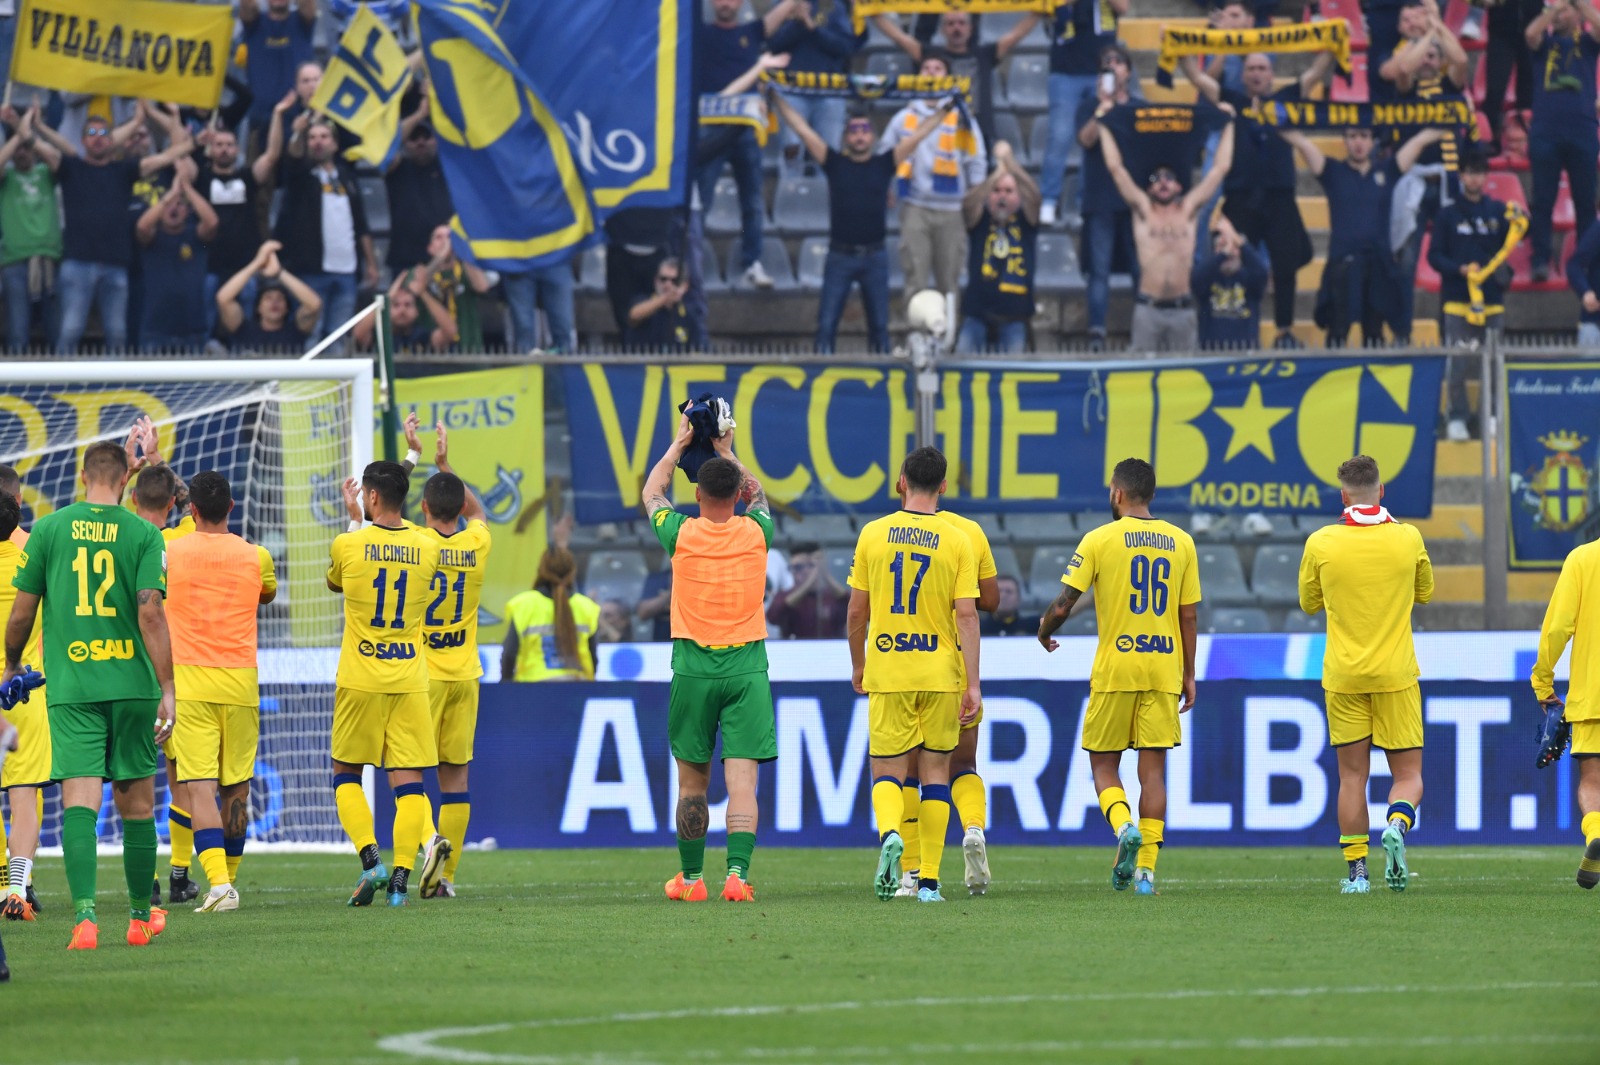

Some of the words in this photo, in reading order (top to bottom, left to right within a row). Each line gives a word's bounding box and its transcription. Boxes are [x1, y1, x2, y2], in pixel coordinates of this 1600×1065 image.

[32, 9, 213, 77] VILLANOVA
[582, 363, 1060, 509] VECCHIE
[1191, 482, 1320, 508] MODENA
[71, 520, 119, 543] SECULIN
[887, 526, 940, 551] MARSURA
[1124, 531, 1176, 552] OUKHADDA
[364, 543, 421, 566] FALCINELLI
[72, 547, 117, 617] 12
[889, 551, 932, 615] 17
[1129, 554, 1171, 617] 96
[370, 568, 408, 629] 11
[425, 570, 466, 627] 21
[90, 640, 135, 661] SAU
[375, 643, 417, 660] SAU
[428, 629, 467, 650] SAU
[894, 633, 939, 652] SAU
[1135, 634, 1174, 655] SAU
